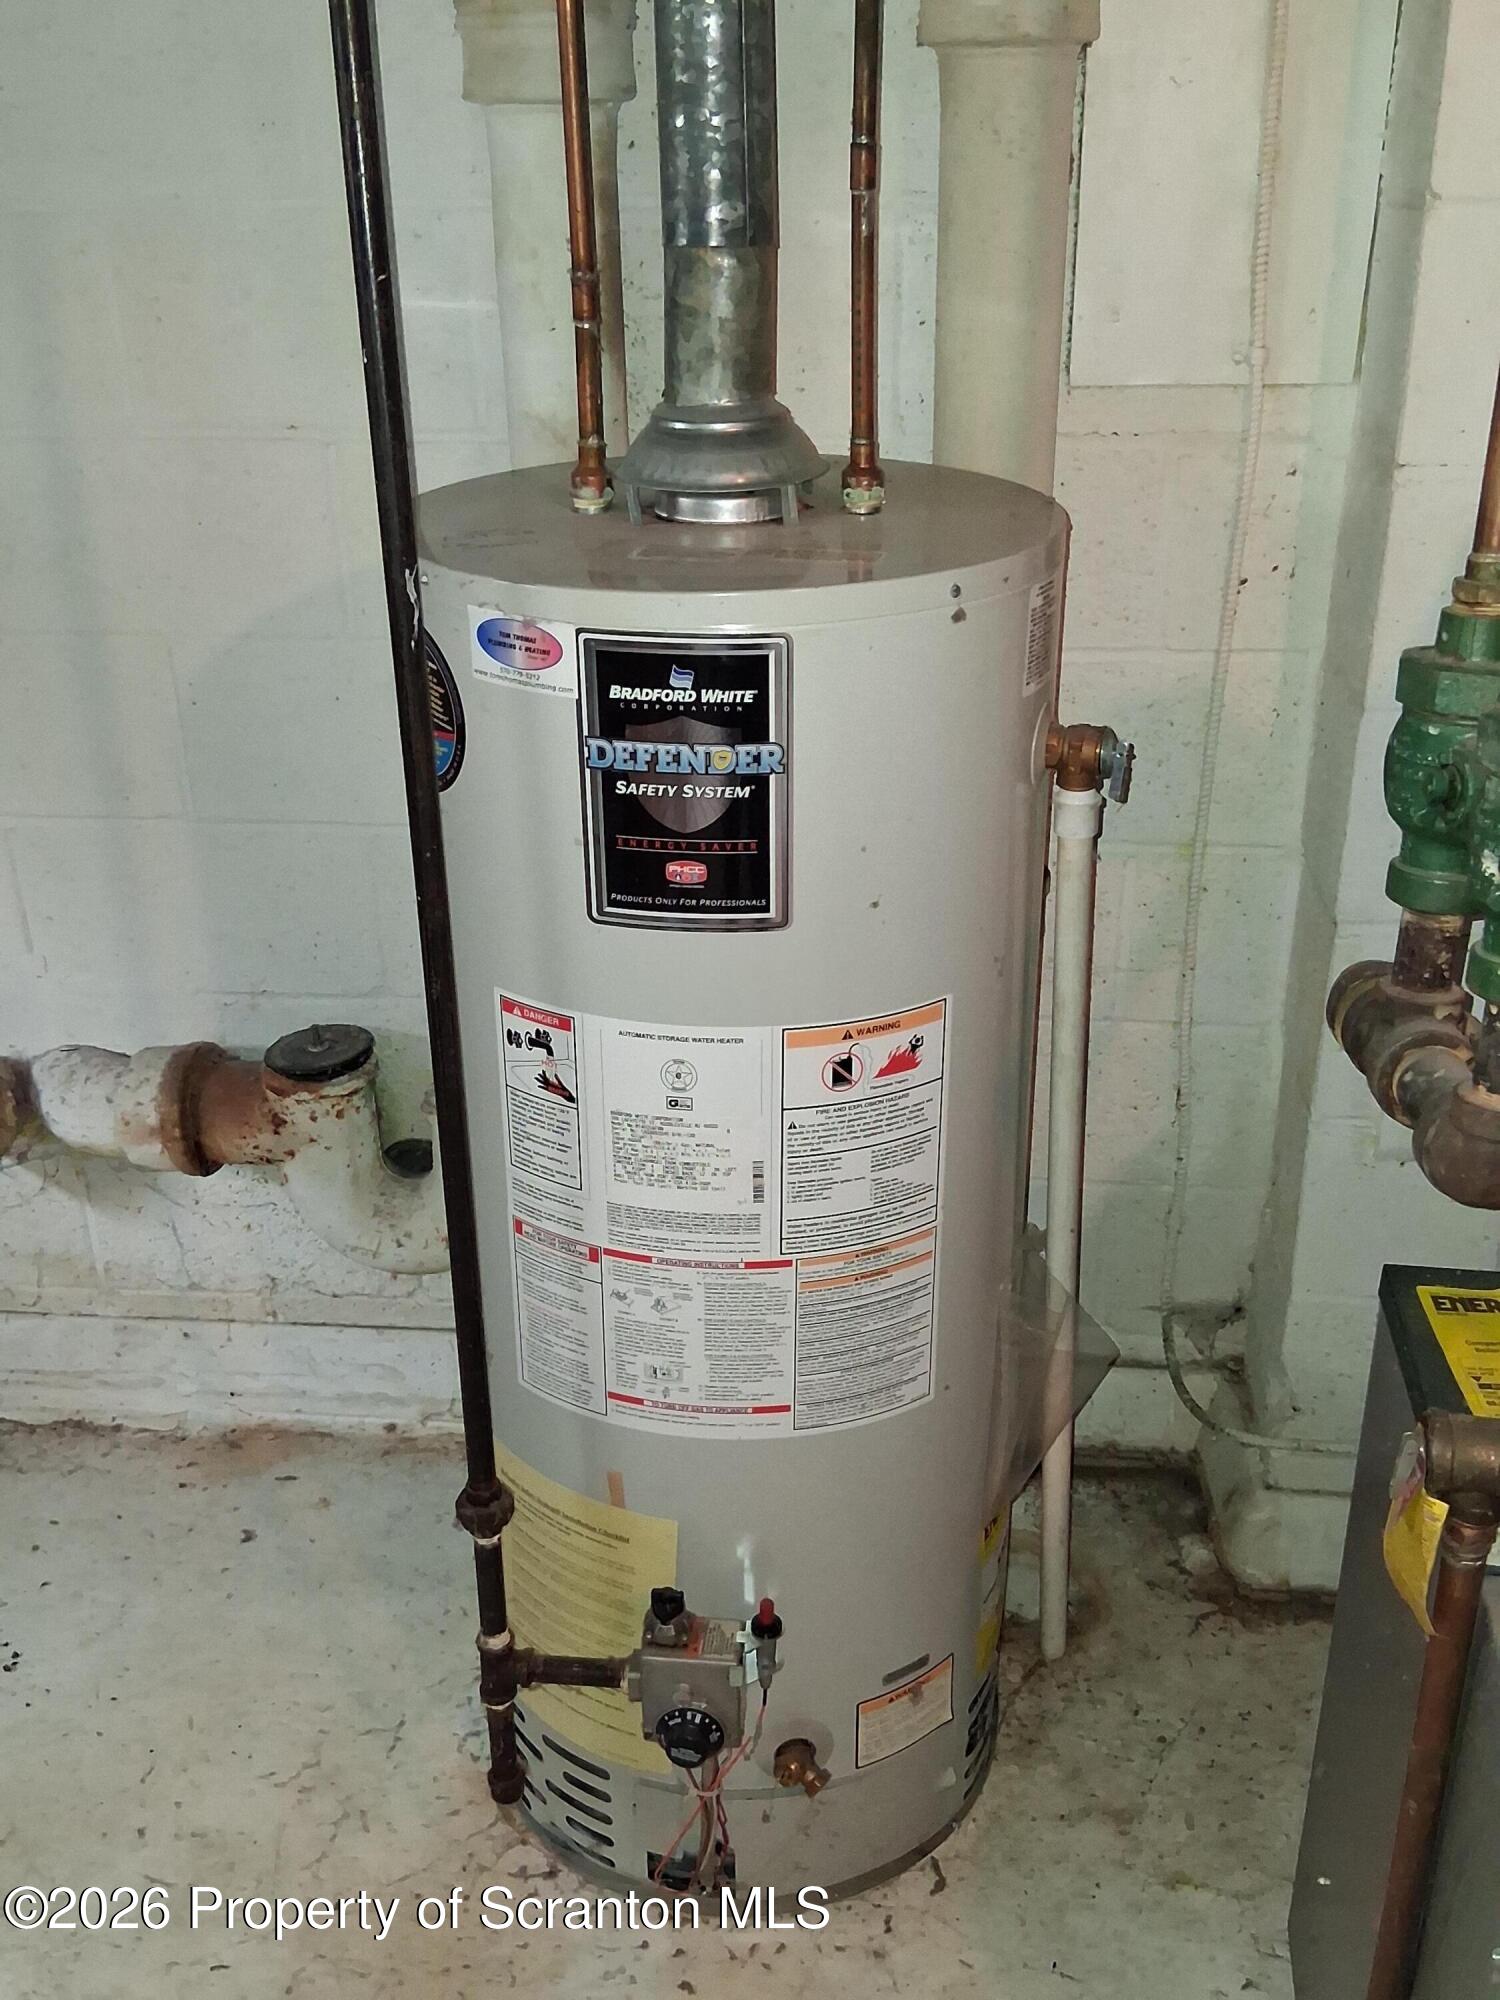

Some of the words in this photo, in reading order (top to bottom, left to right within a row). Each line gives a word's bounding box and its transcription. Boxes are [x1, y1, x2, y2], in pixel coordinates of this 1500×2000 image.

[609, 685, 697, 703] BRADFORD
[701, 689, 755, 703] WHITE
[620, 702, 743, 712] CORPORATION
[585, 736, 785, 775] DEFENDER
[615, 780, 678, 798] SAFETY
[682, 783, 752, 799] SYSTEM
[617, 837, 688, 850] ENERGY
[701, 841, 757, 851] SAVER
[668, 865, 706, 874] PHCC
[610, 893, 653, 904] PRODUCTS
[655, 897, 677, 905] ONLY
[679, 898, 697, 906] FOR
[700, 898, 767, 907] PROFESSIONALS
[523, 1008, 560, 1027] DANGER
[856, 1020, 901, 1037] WARNING
[618, 1030, 657, 1041] AUTOMATIC
[657, 1034, 690, 1043] STORAGE
[691, 1036, 716, 1044] WATER
[716, 1037, 744, 1045] HEATER
